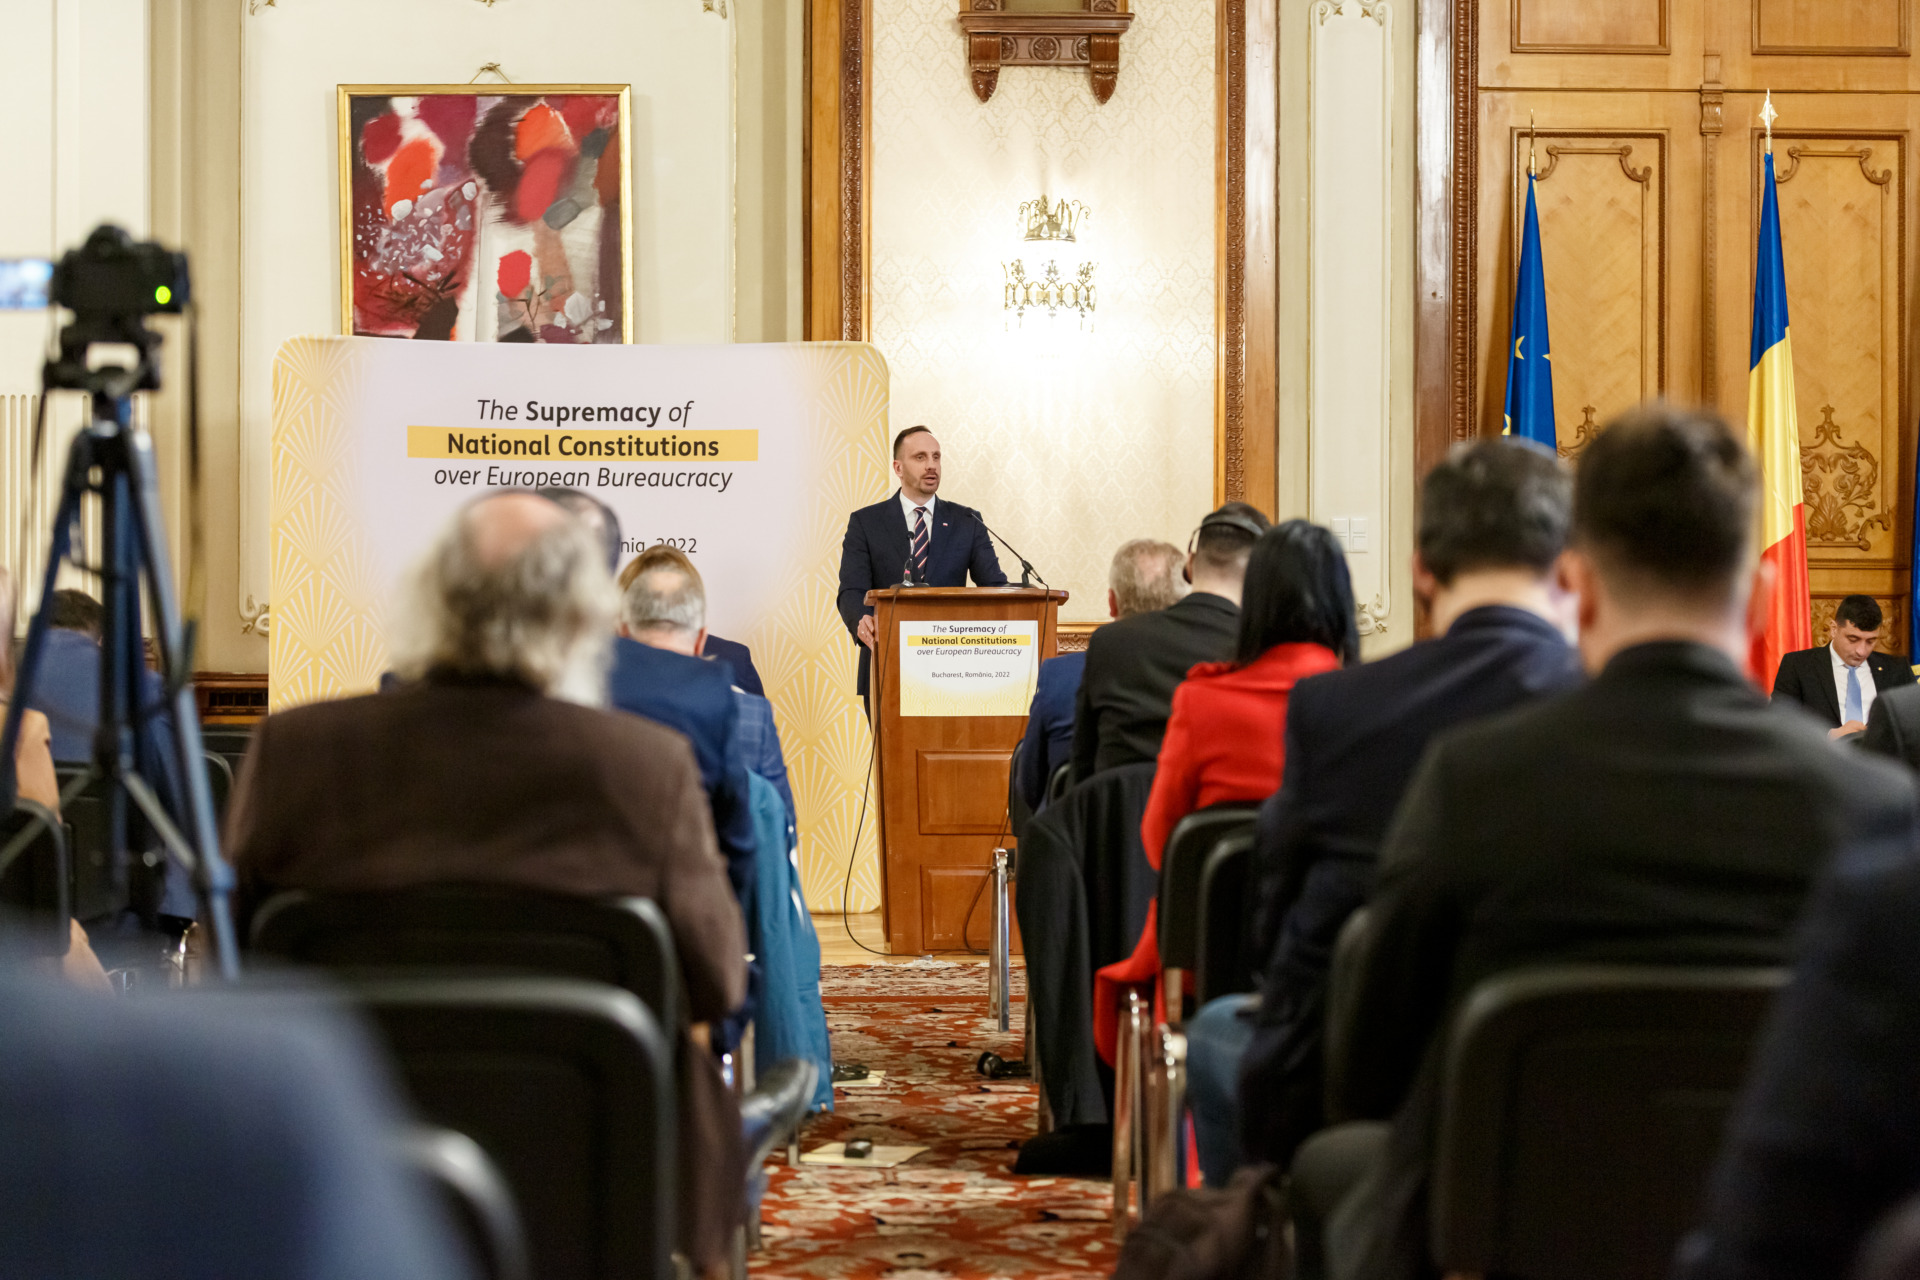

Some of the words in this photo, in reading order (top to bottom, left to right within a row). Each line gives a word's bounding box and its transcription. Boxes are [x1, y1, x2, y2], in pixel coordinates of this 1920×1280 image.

[477, 399, 518, 421] The
[525, 400, 662, 428] Supremacy
[668, 400, 695, 428] of
[447, 433, 551, 457] National
[558, 435, 719, 457] Constitutions
[434, 469, 481, 486] over
[487, 466, 590, 489] European
[597, 467, 734, 493] Bureaucracy
[932, 624, 947, 633] The
[949, 625, 996, 634] Supremacy
[998, 624, 1007, 634] of
[921, 636, 958, 645] National
[960, 636, 1018, 645] Constitutions
[935, 648, 972, 657] European
[974, 648, 1022, 657] Bureaucracy
[931, 671, 964, 679] Bucharest,
[965, 671, 994, 679] România,
